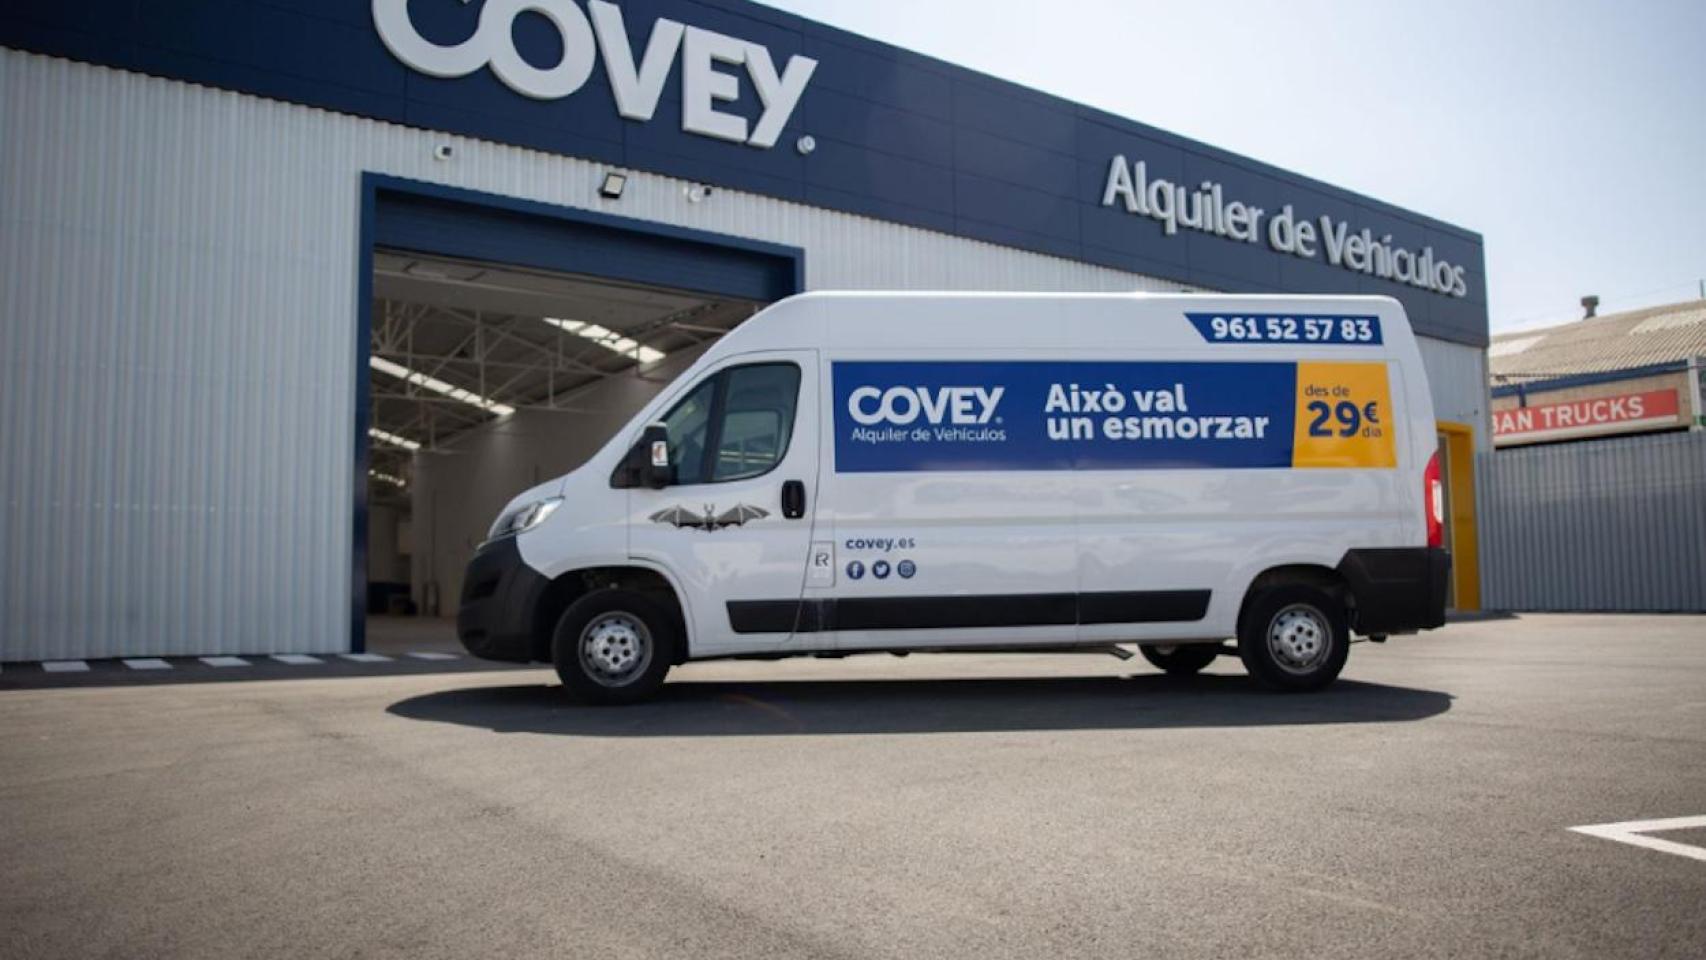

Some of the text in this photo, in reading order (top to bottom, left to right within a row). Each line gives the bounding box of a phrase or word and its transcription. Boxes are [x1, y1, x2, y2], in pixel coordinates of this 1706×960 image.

[373, 0, 818, 148] COVEY
[1102, 154, 1468, 297] Alquiler de Vehículos
[1211, 317, 1373, 341] 961 52 57 83
[1045, 383, 1187, 413] Això val
[1304, 384, 1350, 397] des de
[848, 386, 1005, 425] COVEY
[1541, 396, 1644, 427] TRUCKS
[851, 428, 907, 445] Alquiler
[911, 428, 930, 441] de
[1047, 416, 1269, 440] un esmorzar
[845, 538, 915, 551] covey.es
